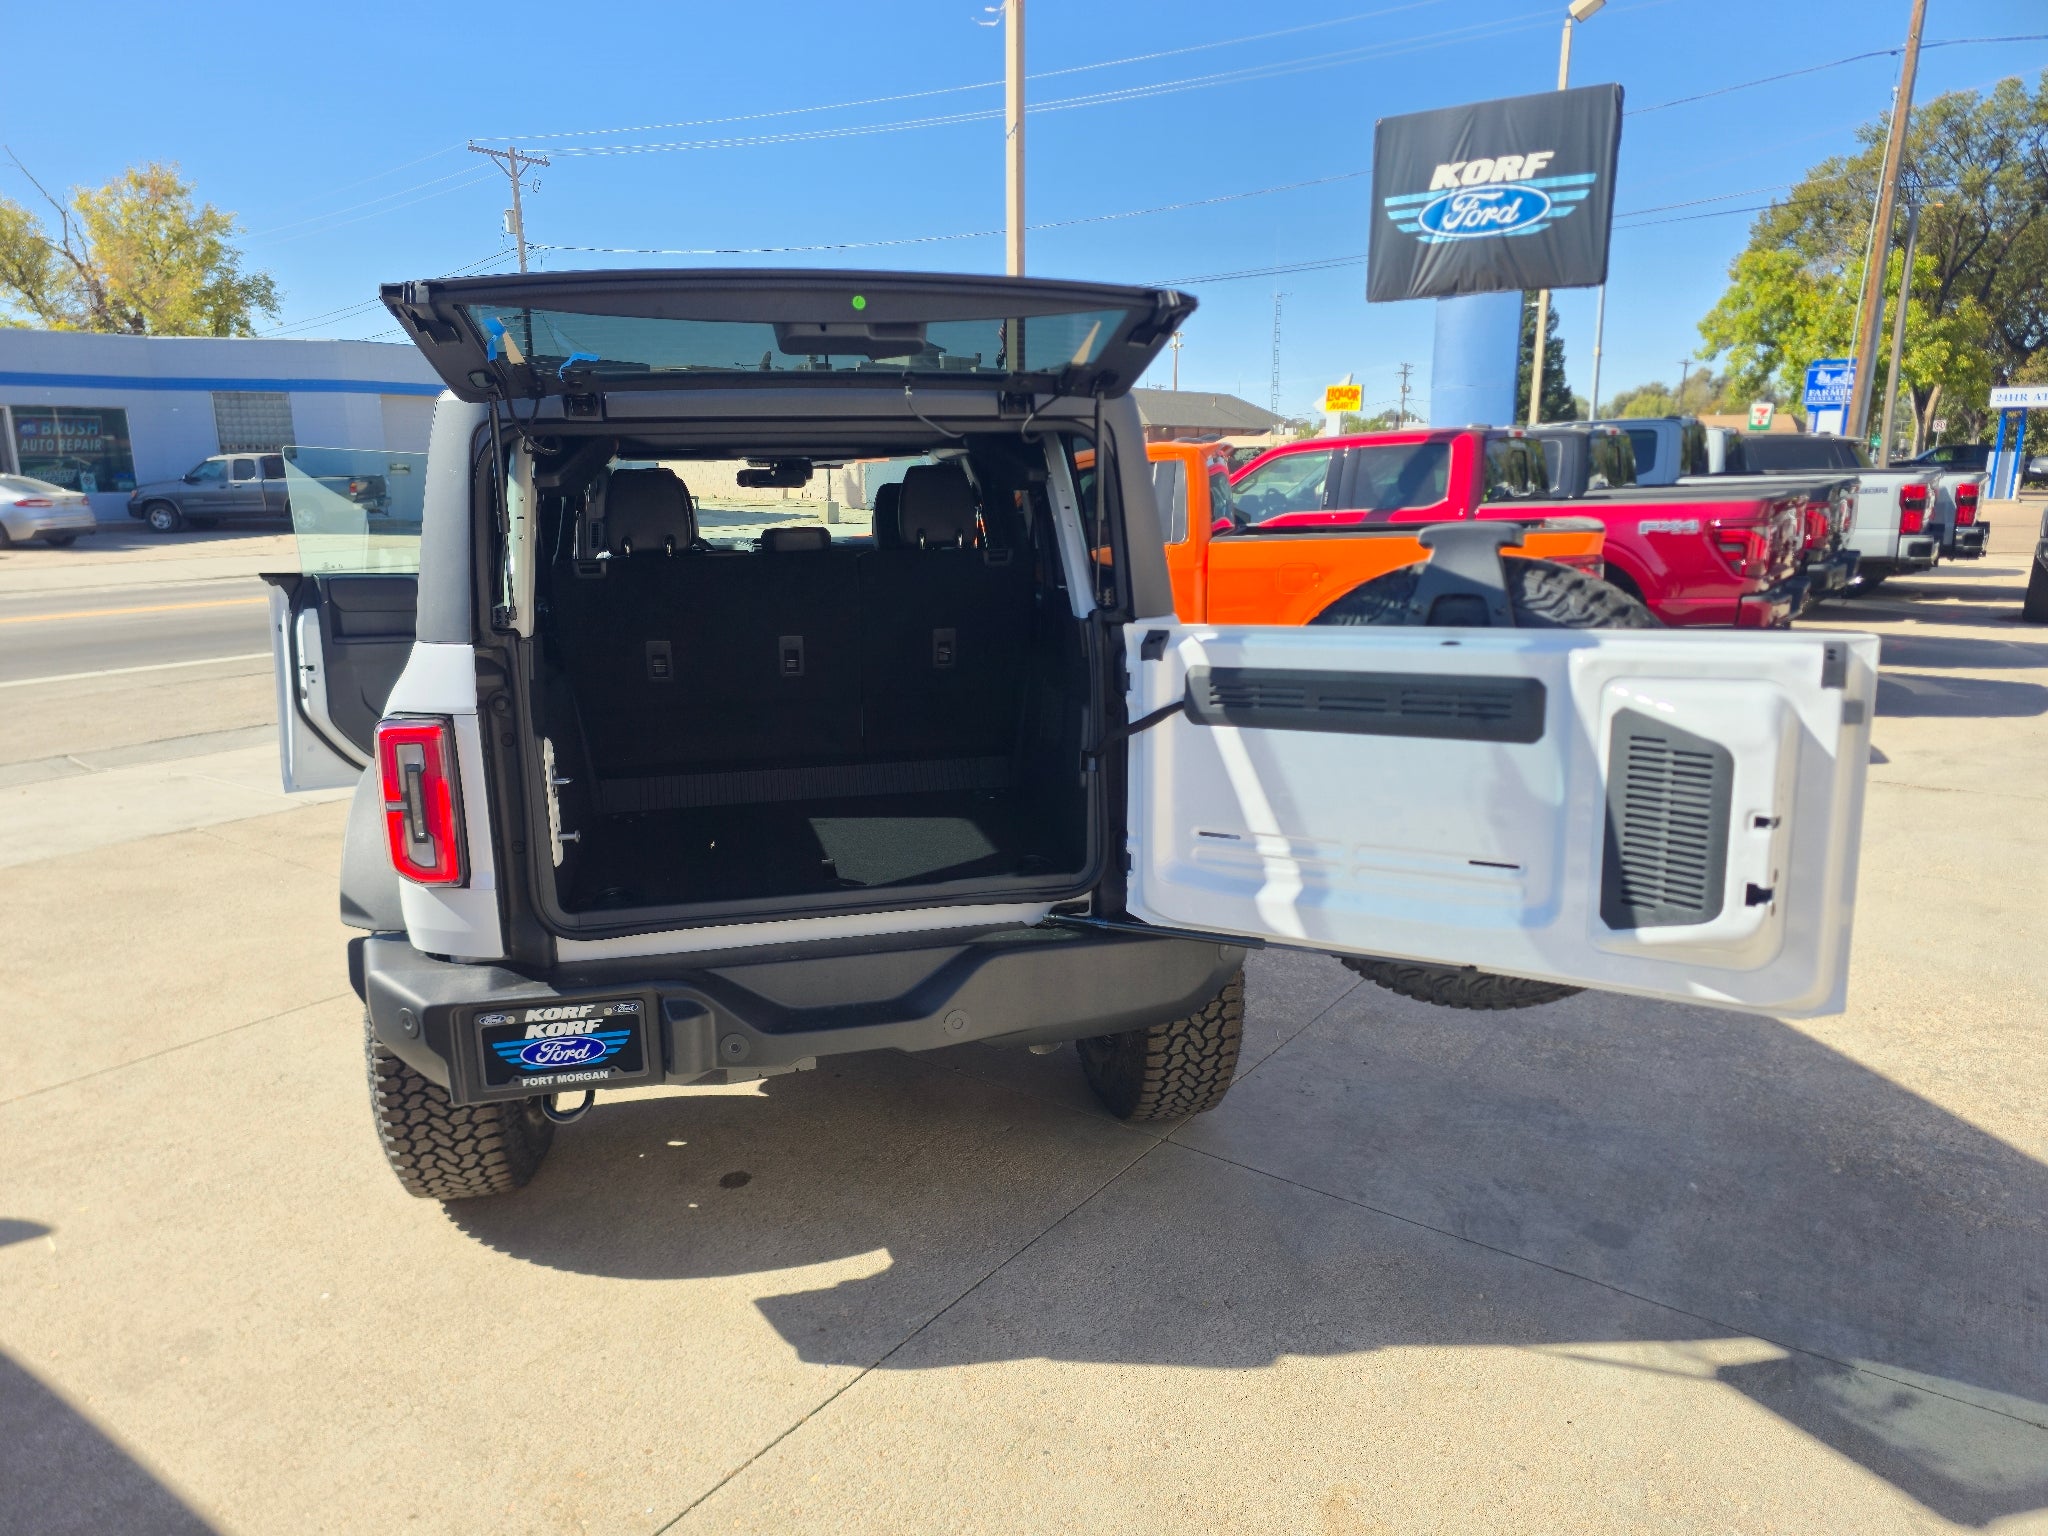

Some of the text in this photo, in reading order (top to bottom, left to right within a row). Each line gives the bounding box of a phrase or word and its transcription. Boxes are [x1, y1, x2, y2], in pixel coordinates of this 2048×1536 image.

[1429, 151, 1555, 191] KORF
[1443, 192, 1523, 230] Ford
[1326, 387, 1360, 401] LIQUOR
[1808, 389, 1853, 397] FARMER
[1996, 392, 2048, 402] 24HR AT
[41, 421, 99, 436] BRUSH
[21, 438, 102, 452] AUTO REPAIR
[1638, 520, 1699, 534] FX4
[525, 1004, 596, 1022] KORF
[525, 1019, 603, 1039] KORF
[535, 1040, 591, 1063] Ford
[522, 1071, 609, 1087] FORT MORGAN
